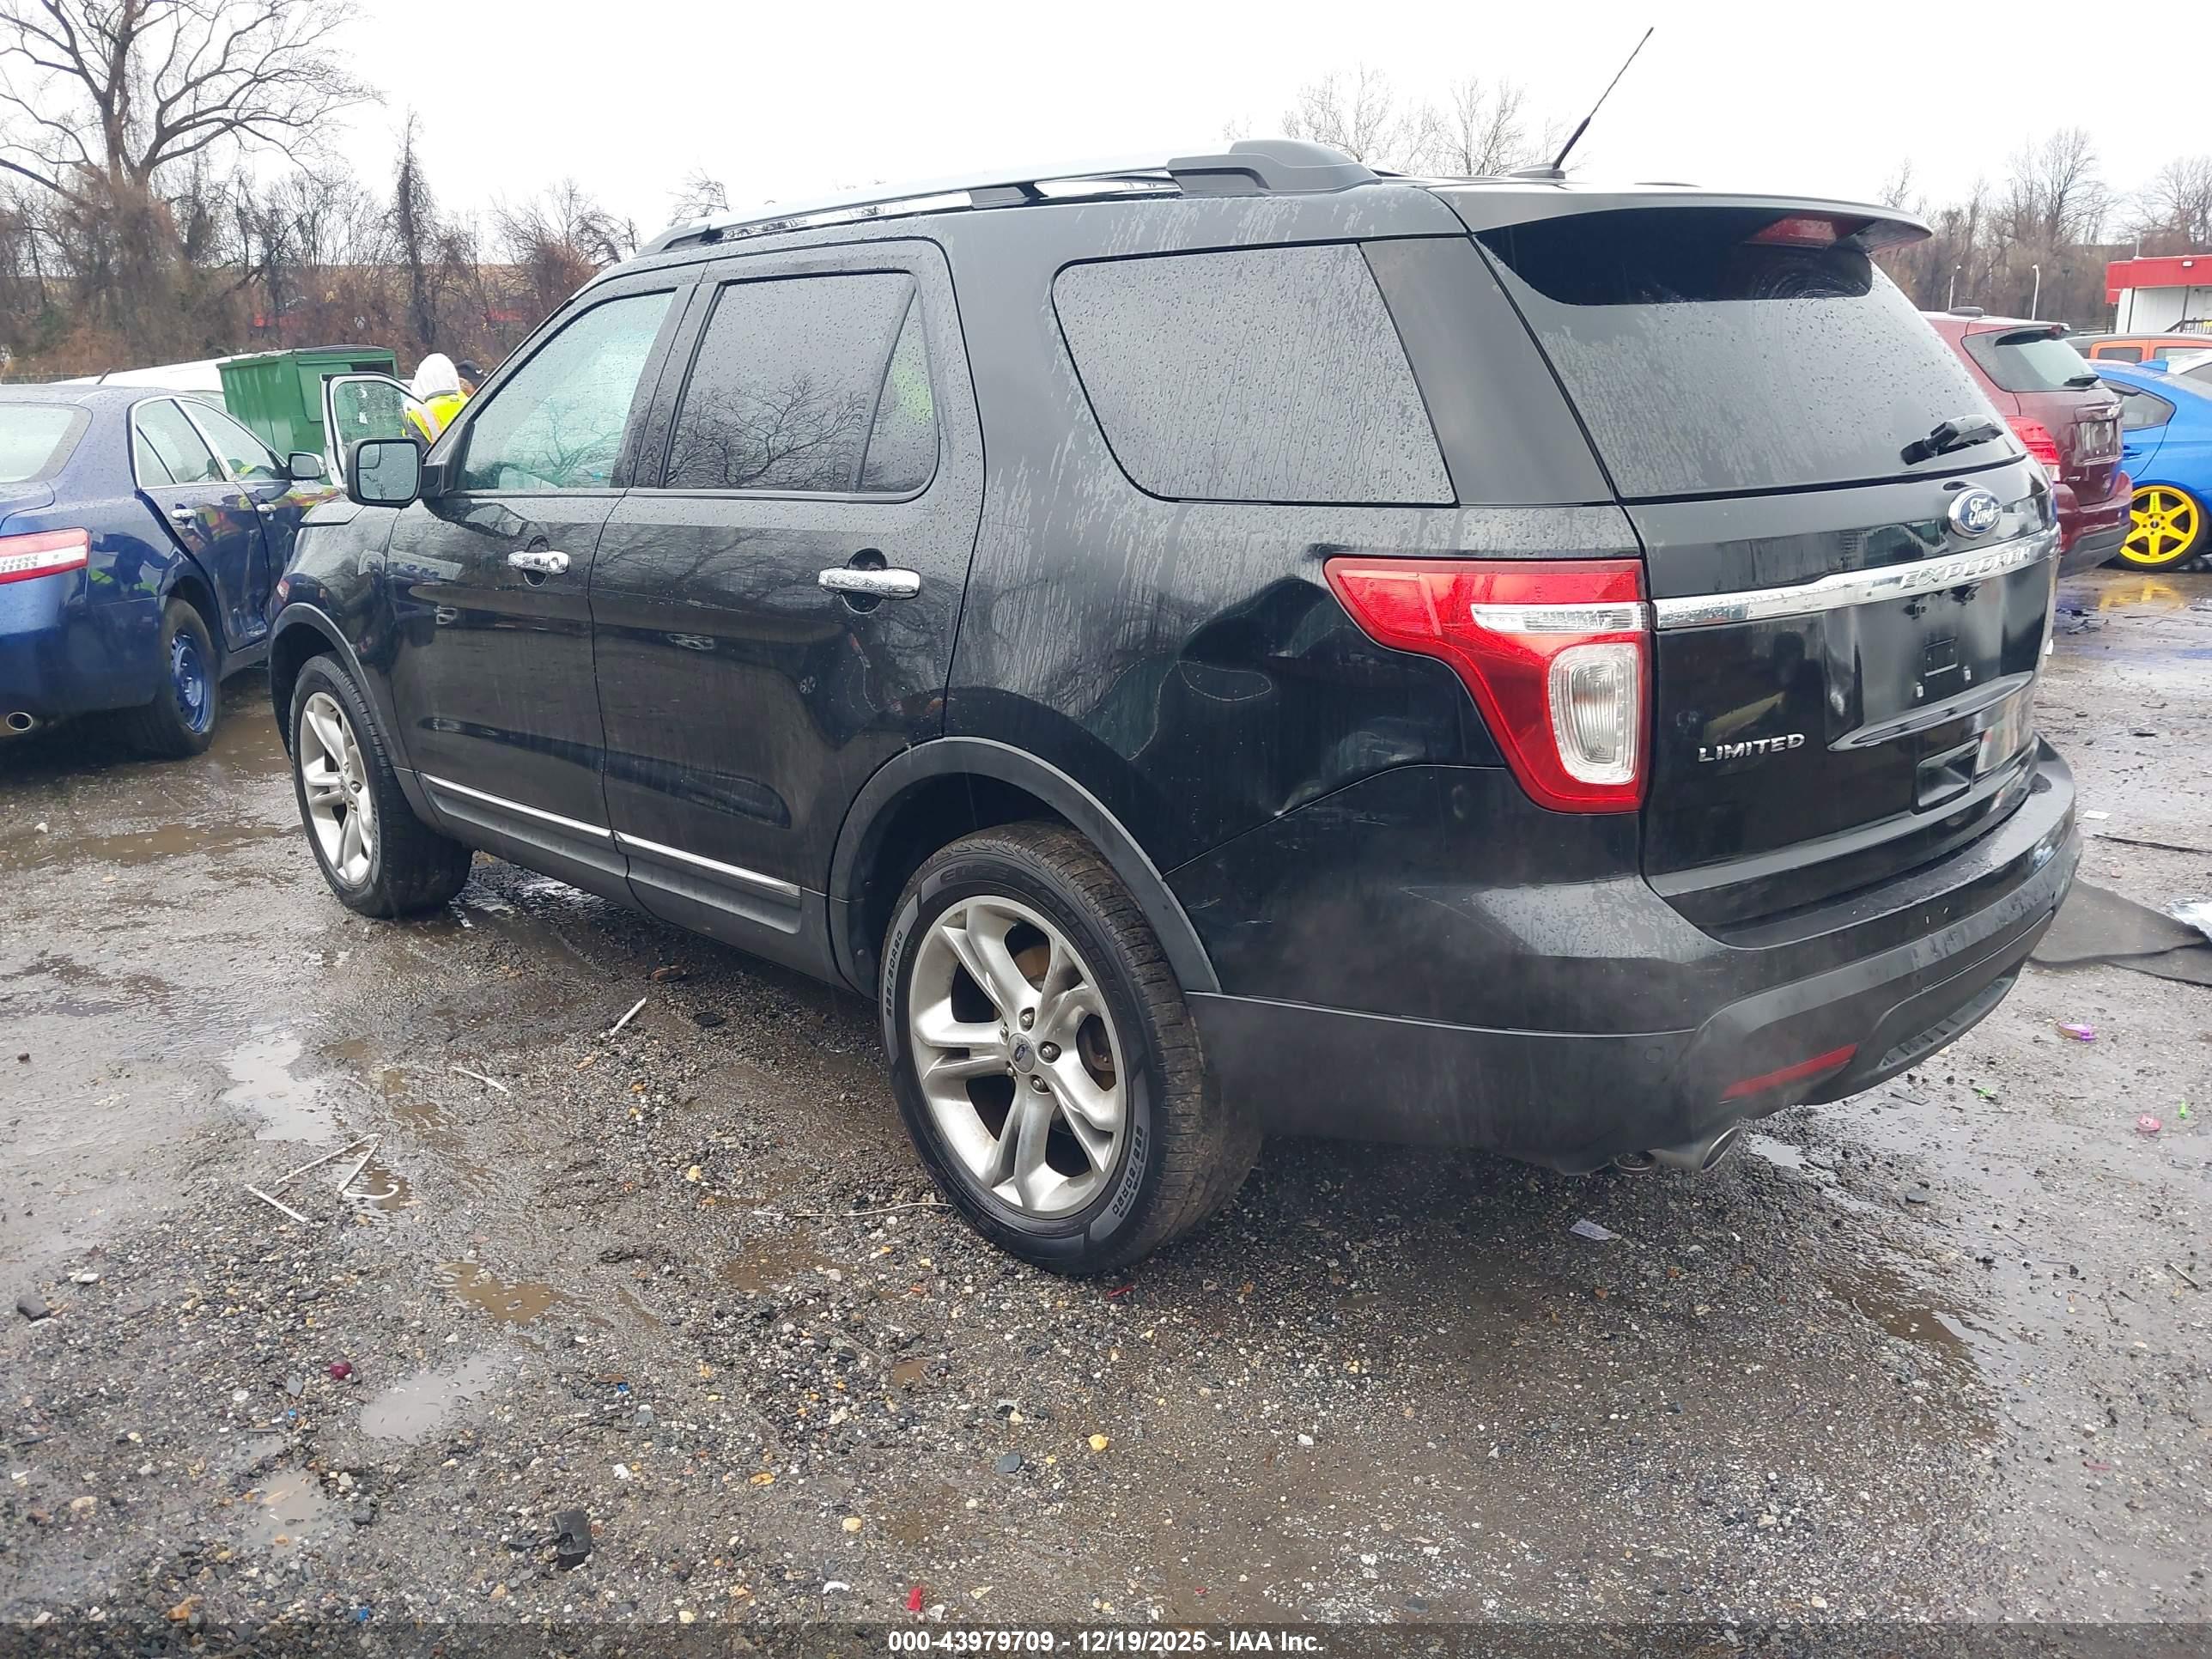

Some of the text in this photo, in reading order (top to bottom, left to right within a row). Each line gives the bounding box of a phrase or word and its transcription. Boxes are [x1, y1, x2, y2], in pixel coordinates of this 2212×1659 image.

[1967, 497, 2000, 526] Ford
[1899, 546, 2032, 590] EXPLORER
[1698, 733, 1805, 763] LIMITED
